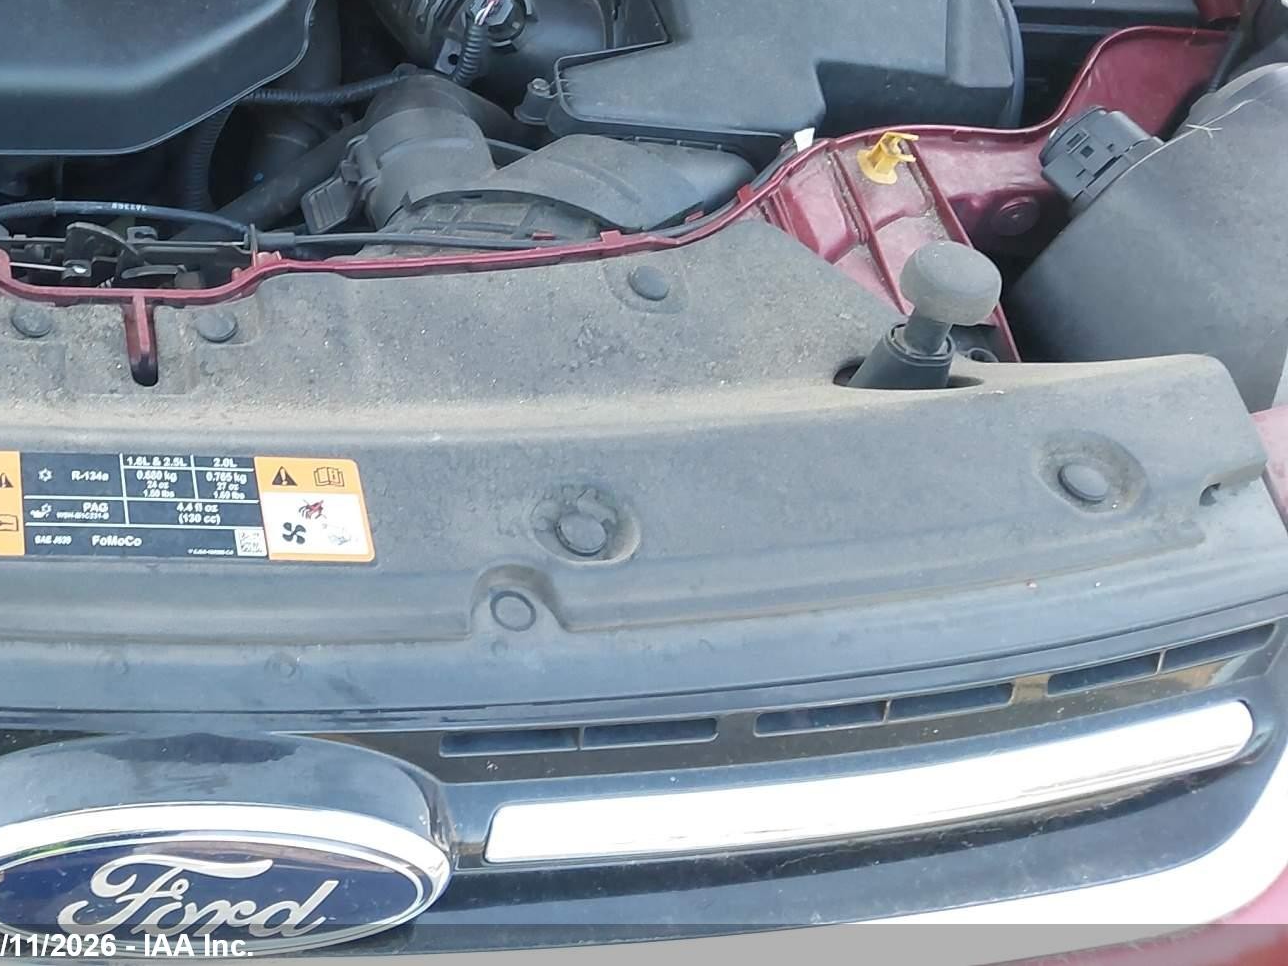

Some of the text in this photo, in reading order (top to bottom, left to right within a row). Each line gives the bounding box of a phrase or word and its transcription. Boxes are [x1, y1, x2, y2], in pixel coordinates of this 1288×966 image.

[163, 457, 187, 467] 2.5L
[213, 458, 238, 468] 2.0L
[71, 470, 109, 481] R-134a
[164, 471, 177, 483] kg
[234, 472, 248, 484] kg
[228, 483, 239, 491] oz
[83, 502, 109, 512] PAG
[176, 502, 193, 512] 4.4
[204, 504, 219, 513] oz
[178, 513, 221, 525] (130 cc)
[92, 534, 143, 546] FoMoCo
[57, 854, 339, 937] Ford
